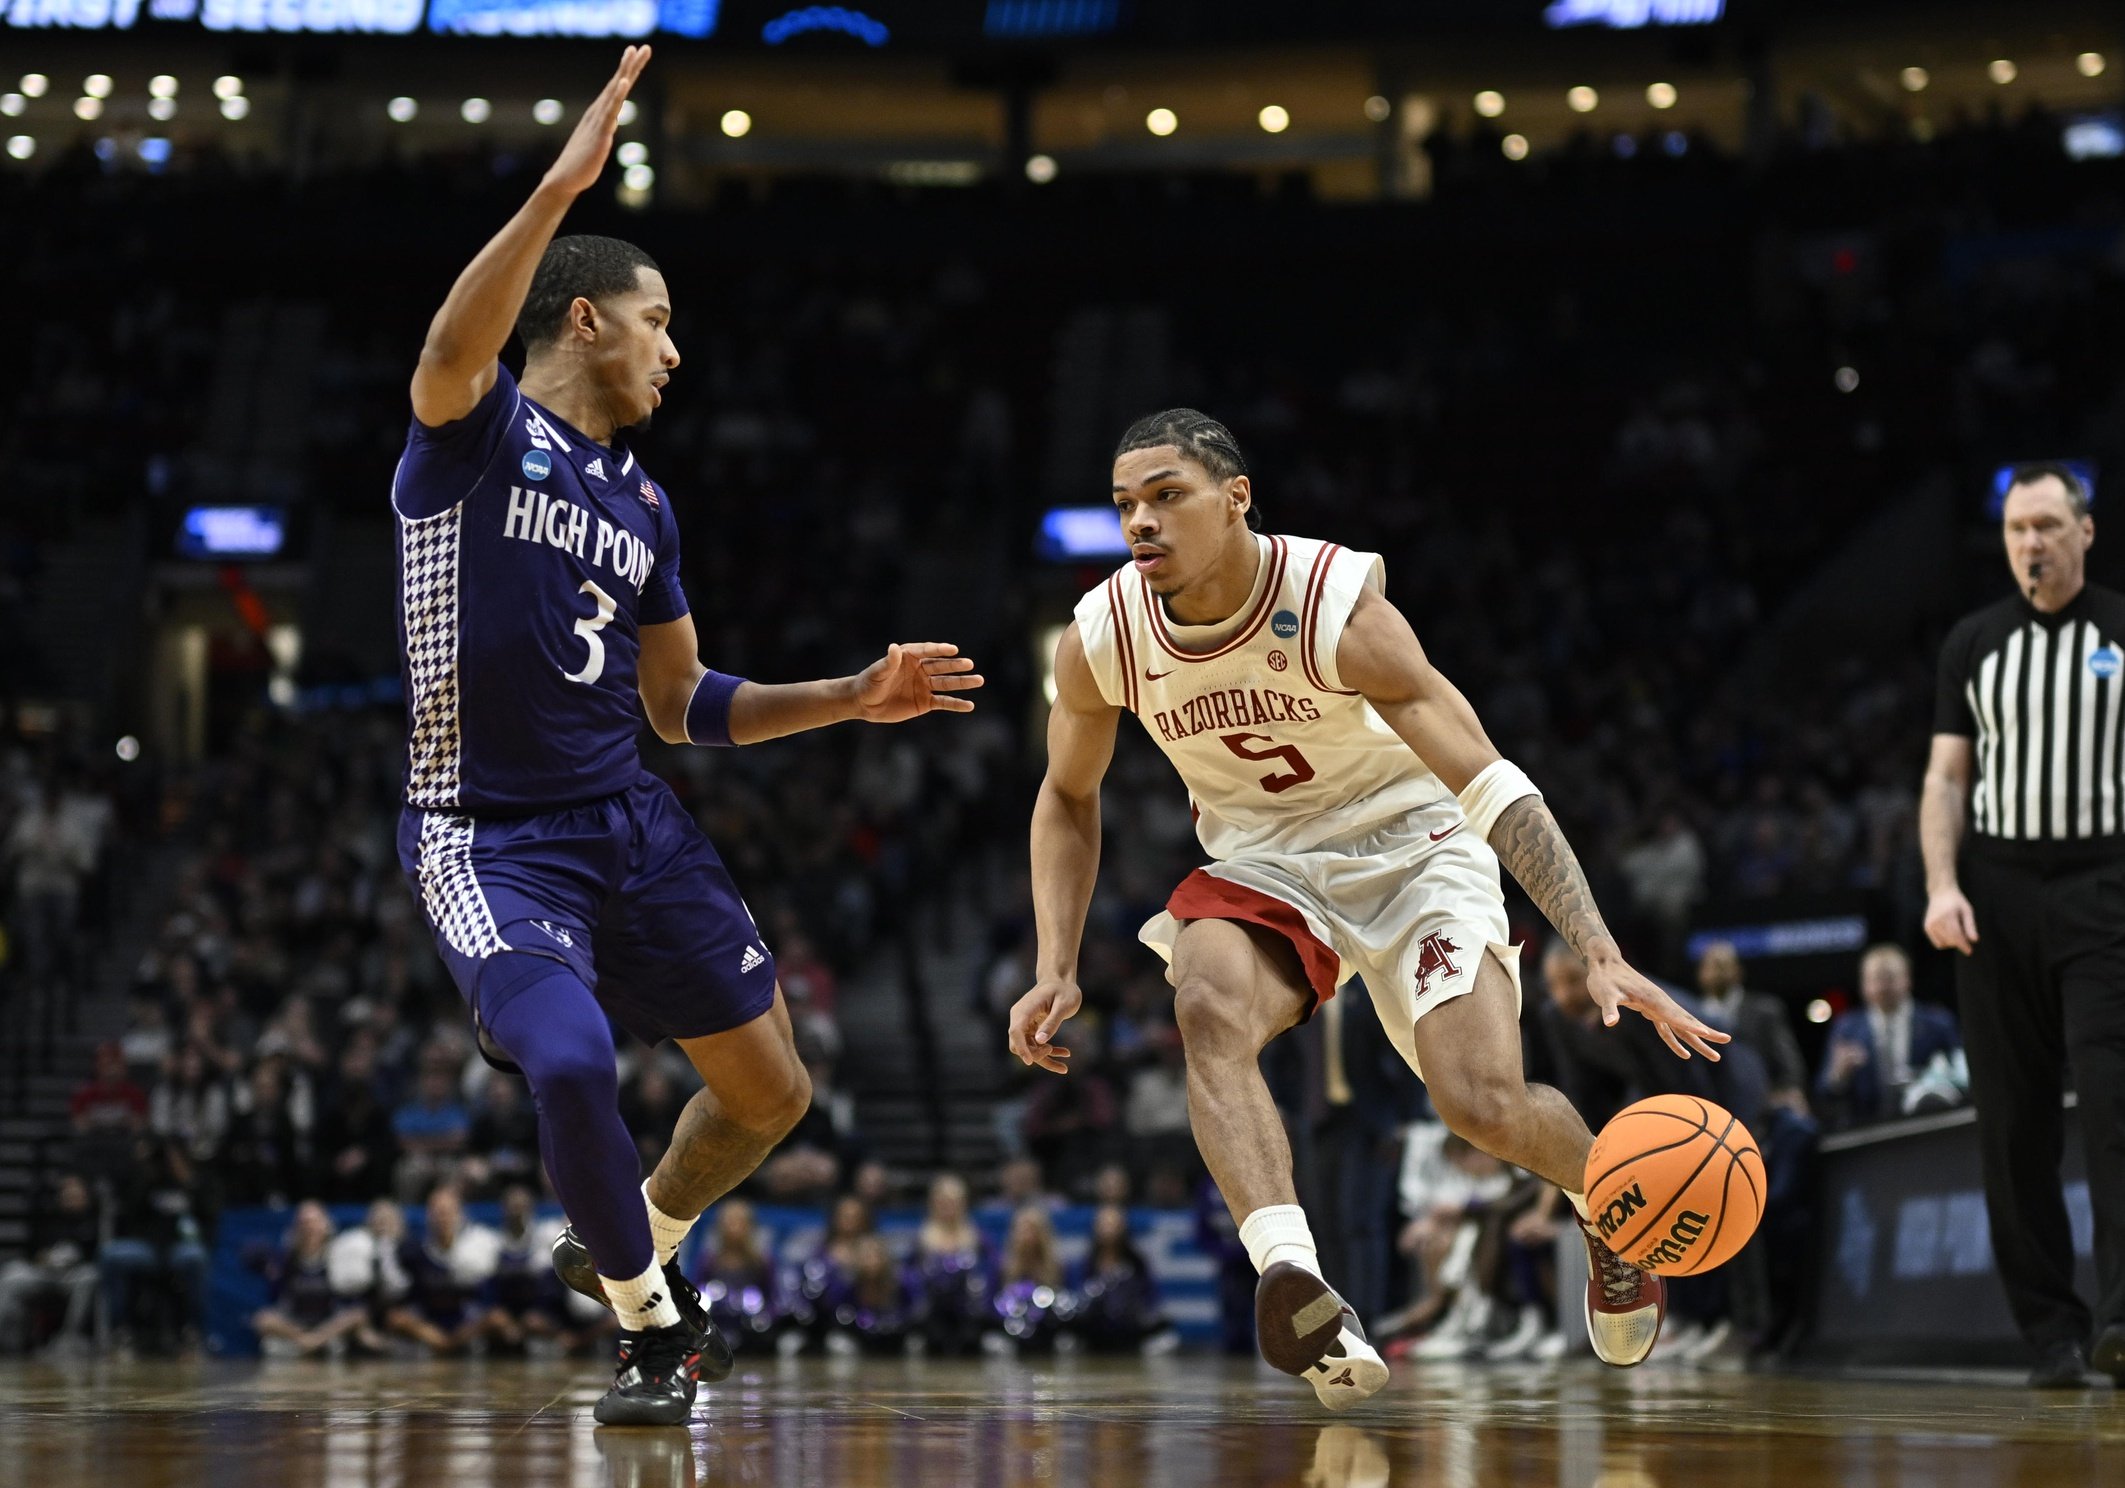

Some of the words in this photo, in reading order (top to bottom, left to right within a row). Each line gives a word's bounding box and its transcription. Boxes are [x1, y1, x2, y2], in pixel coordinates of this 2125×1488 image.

[0, 0, 139, 28] IRST
[503, 485, 589, 559] HIGH
[592, 517, 655, 597] POIN
[558, 579, 618, 686] 3
[1274, 623, 1297, 632] NCAA
[1269, 651, 1286, 671] SEC
[1153, 688, 1322, 743] RAZORBACKS
[1219, 732, 1316, 794] 5
[740, 954, 765, 974] adidas
[1595, 1182, 1648, 1241] NCAA
[1637, 1209, 1710, 1272] Wilso
